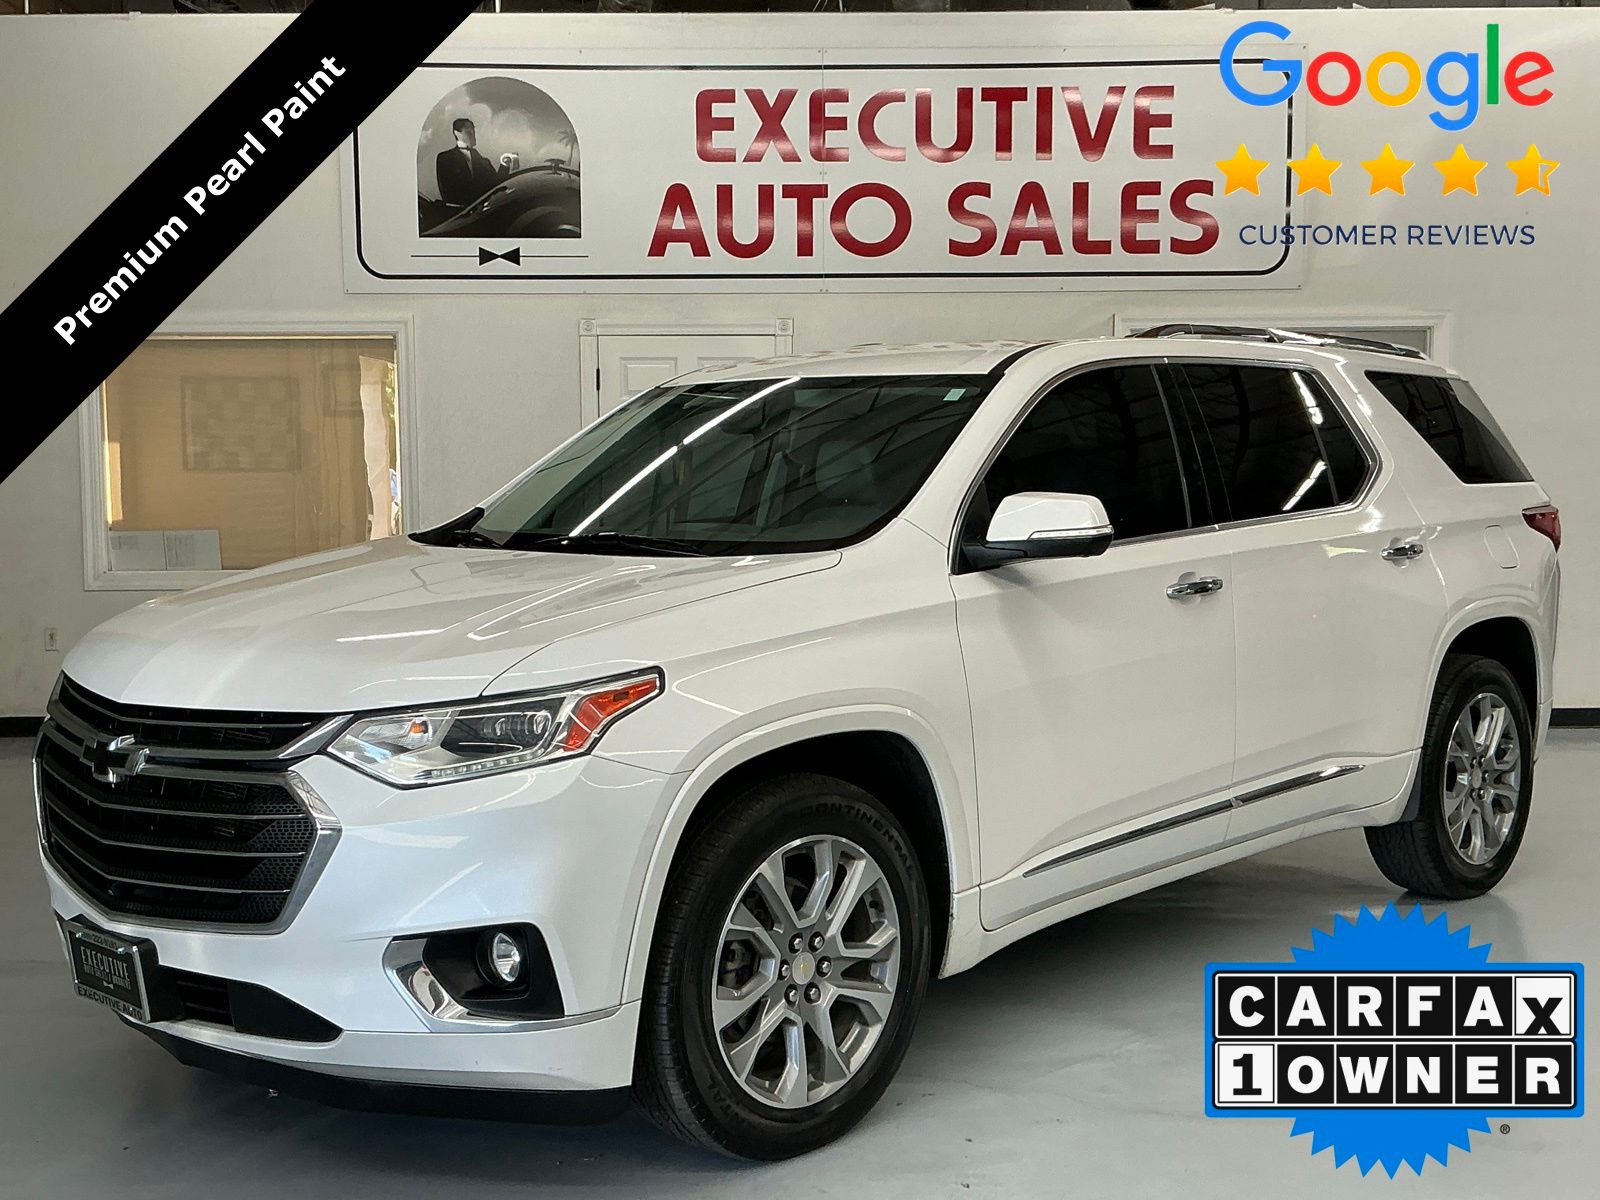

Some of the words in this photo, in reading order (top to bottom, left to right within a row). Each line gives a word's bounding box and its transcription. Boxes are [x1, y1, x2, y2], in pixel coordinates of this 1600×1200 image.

[695, 85, 1175, 163] EXECUTIVE
[647, 182, 912, 258] AUTO
[947, 179, 1220, 256] SALES
[80, 945, 129, 980] EXECUTIVE
[77, 986, 121, 1010] EXECUTIVE
[121, 1001, 143, 1021] AUTO
